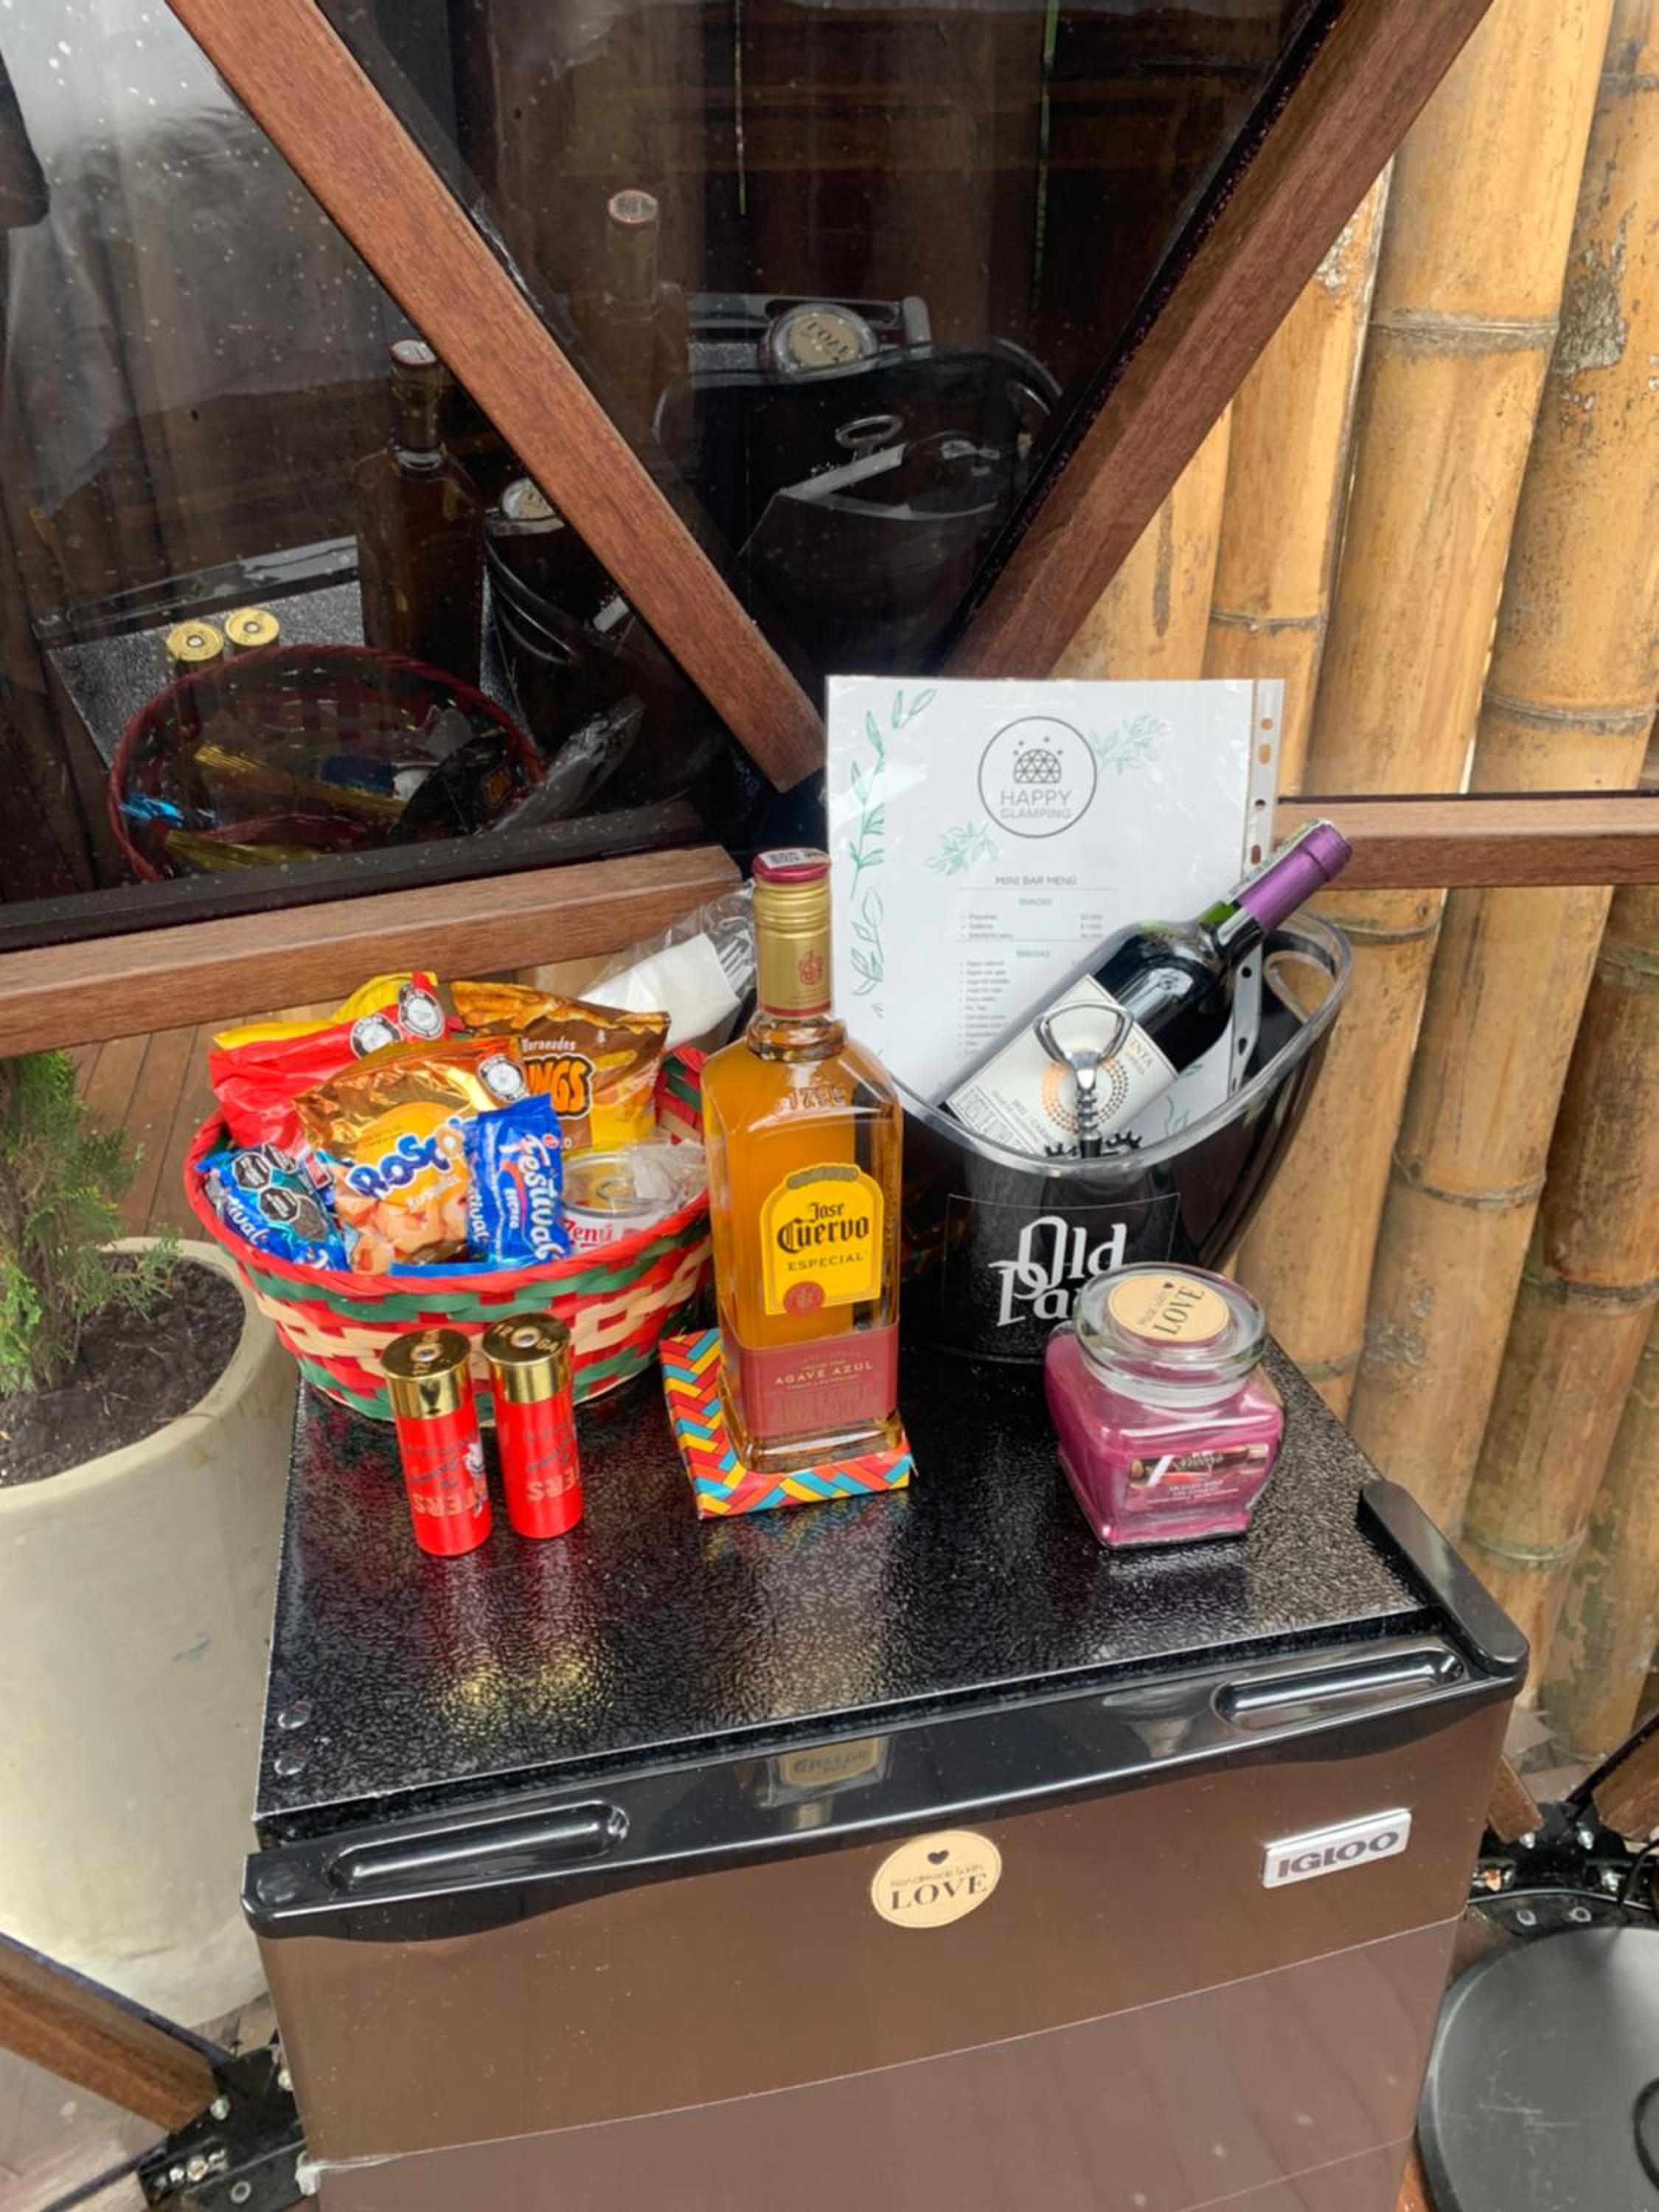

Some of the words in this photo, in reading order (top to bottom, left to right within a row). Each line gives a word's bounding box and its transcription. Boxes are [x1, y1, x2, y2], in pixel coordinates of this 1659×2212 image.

[1000, 789, 1073, 807] HAPPY
[1001, 808, 1072, 820] GLAMPING
[995, 876, 1020, 886] MINI
[1023, 876, 1044, 886] BAR
[499, 1133, 566, 1260] Festival
[776, 1216, 869, 1254] Cuervo
[1018, 1215, 1127, 1290] Old
[787, 1253, 864, 1272] ESPECIAL
[1152, 1285, 1205, 1335] LOVE
[775, 1368, 827, 1385] AGAVE
[832, 1360, 874, 1375] AZUL
[1277, 1831, 1400, 1879] IGLOO
[891, 1873, 987, 1910] LOVE
